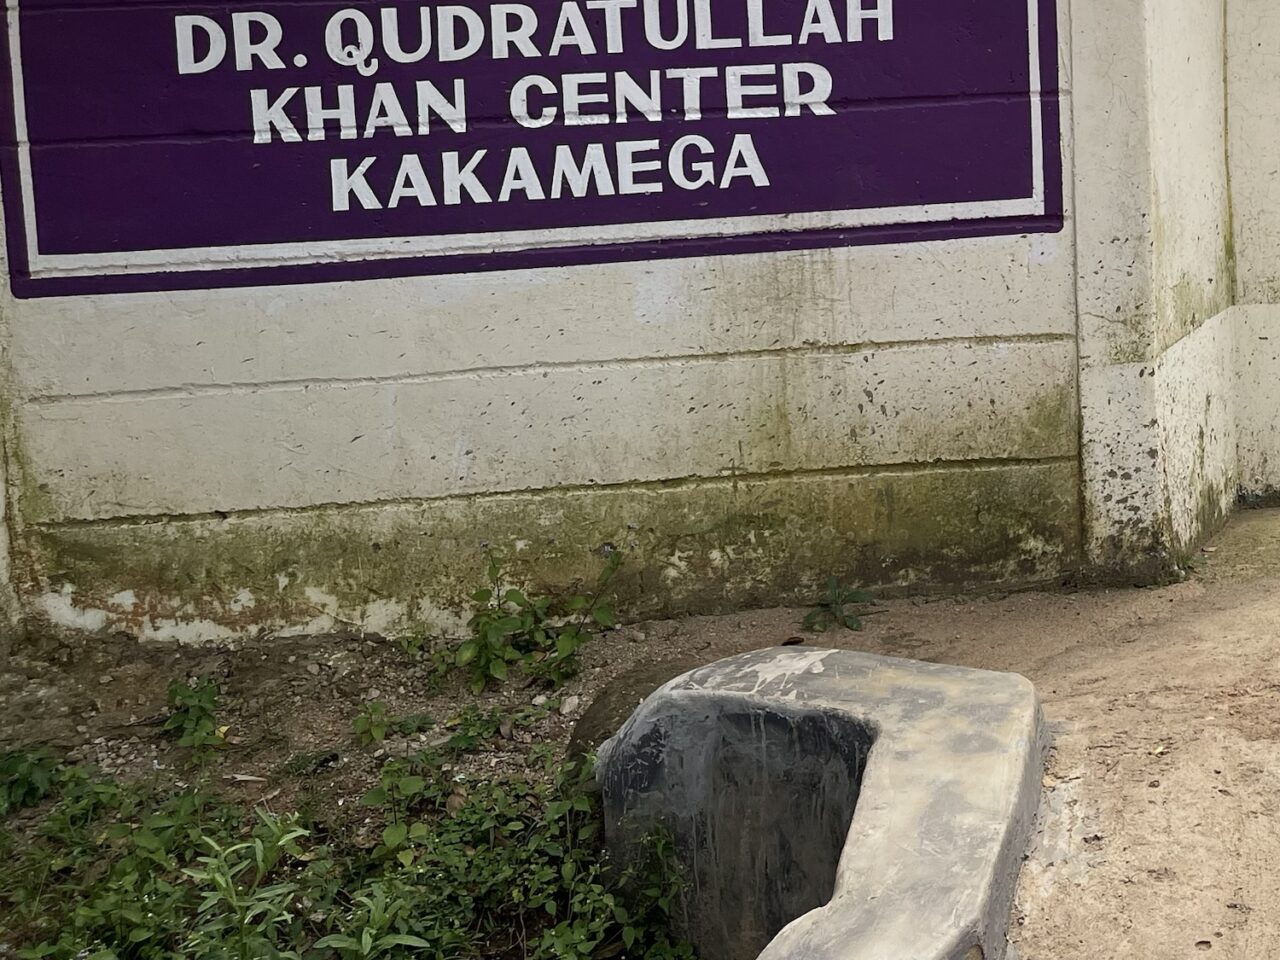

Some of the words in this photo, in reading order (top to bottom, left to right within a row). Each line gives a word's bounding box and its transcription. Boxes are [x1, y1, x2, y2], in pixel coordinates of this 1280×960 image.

[174, 10, 308, 76] DR.
[249, 78, 467, 145] KHAN
[508, 62, 837, 130] CENTER
[329, 133, 771, 213] KAKAMEGA
